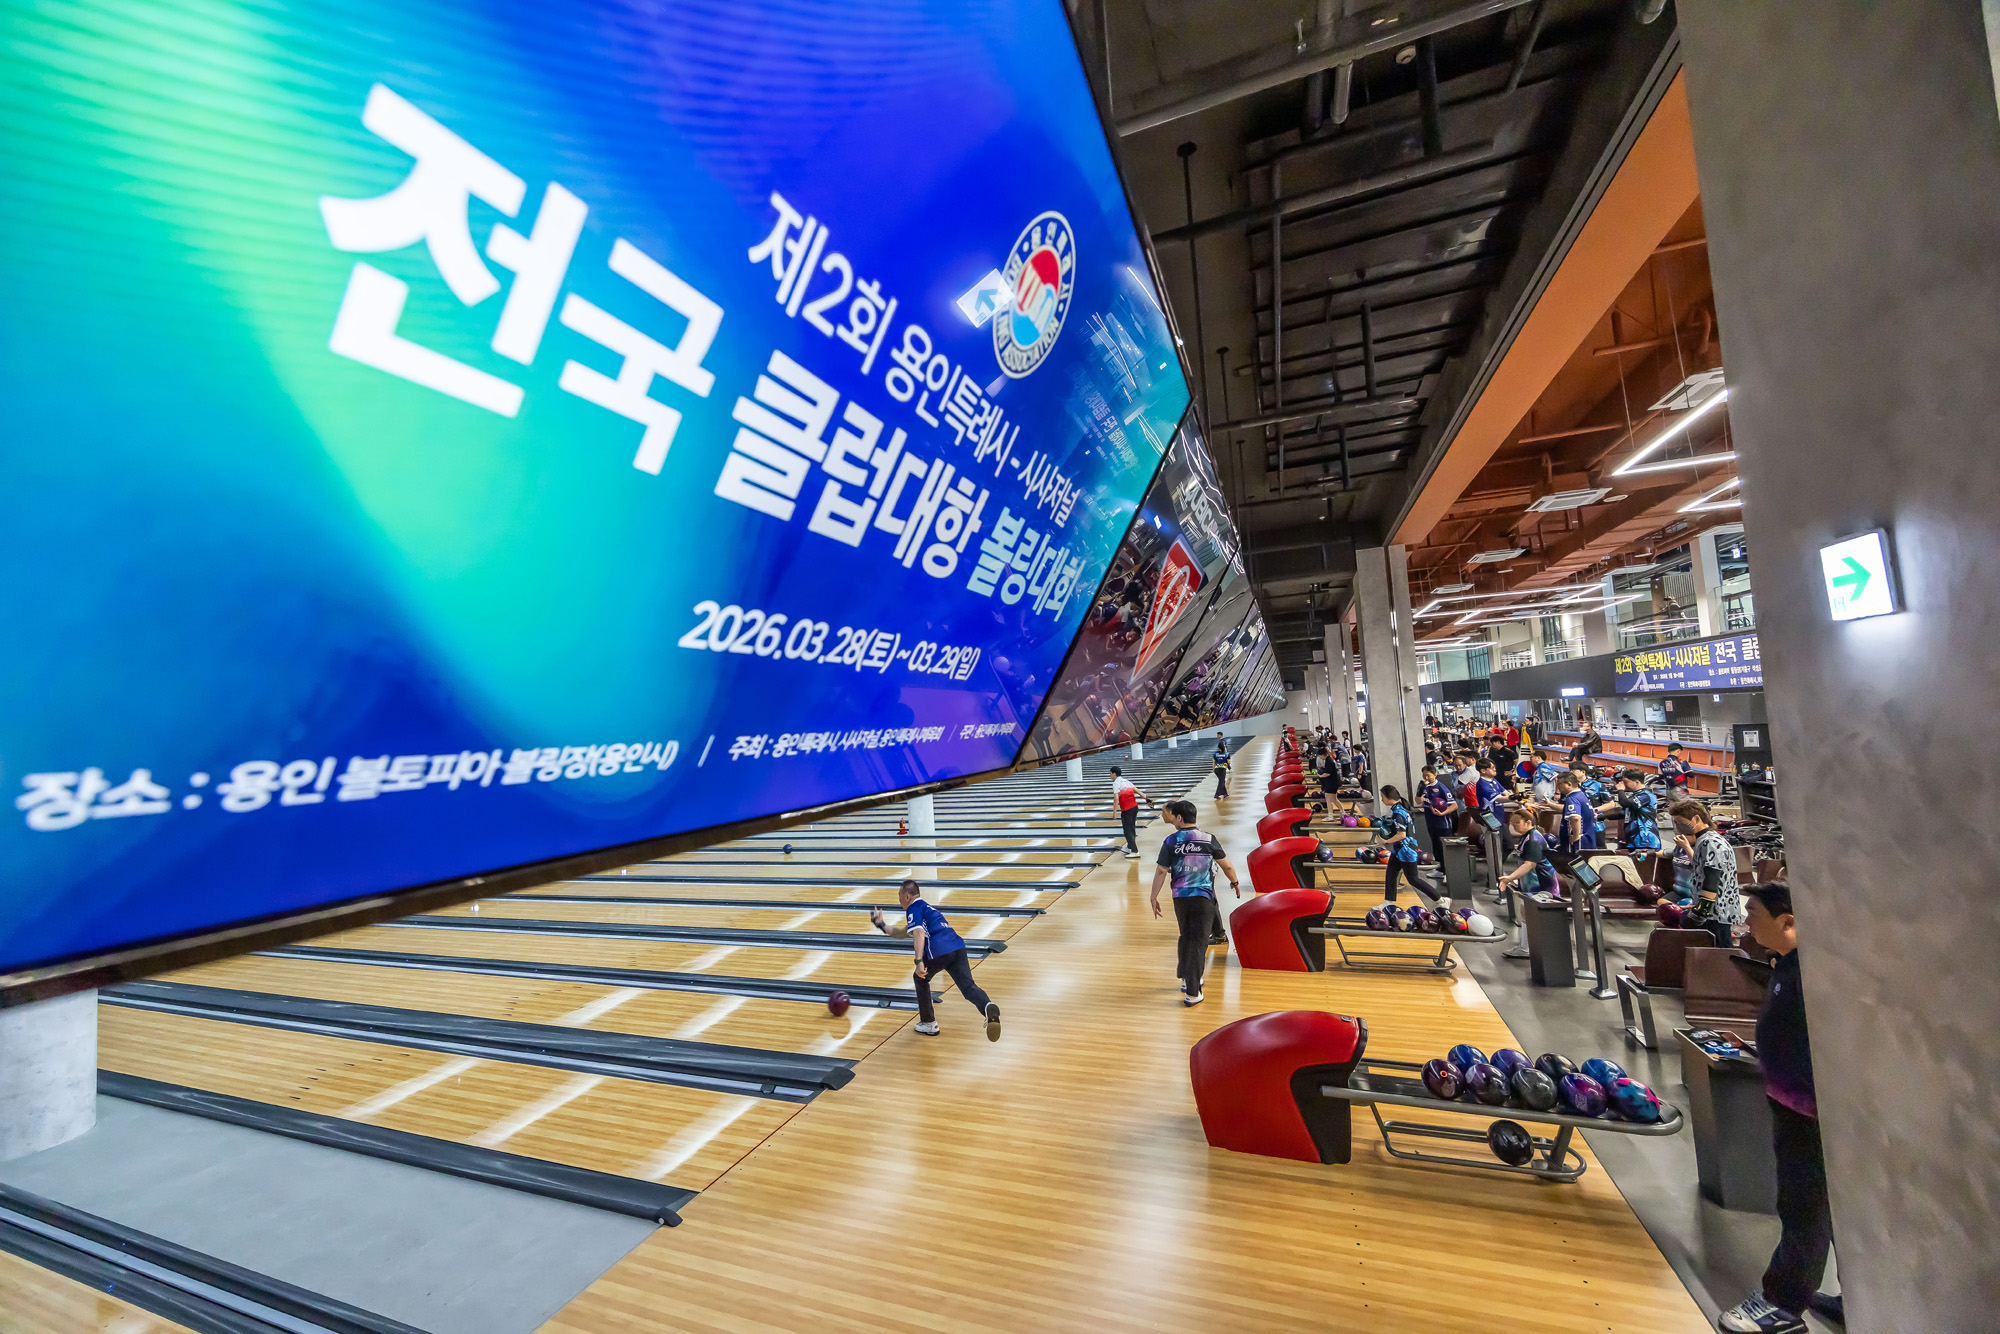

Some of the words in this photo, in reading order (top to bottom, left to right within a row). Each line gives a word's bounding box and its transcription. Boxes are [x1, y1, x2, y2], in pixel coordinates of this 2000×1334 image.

[748, 190, 898, 375] 제2회
[319, 81, 726, 477] 전국
[714, 349, 990, 579] 클럽대항
[966, 506, 1087, 622] 볼링대회
[1614, 655, 1633, 675] 제2회
[1714, 641, 1737, 664] 전국
[15, 766, 172, 832] 장소
[216, 756, 337, 813] 용인
[337, 749, 503, 802] 볼토피아
